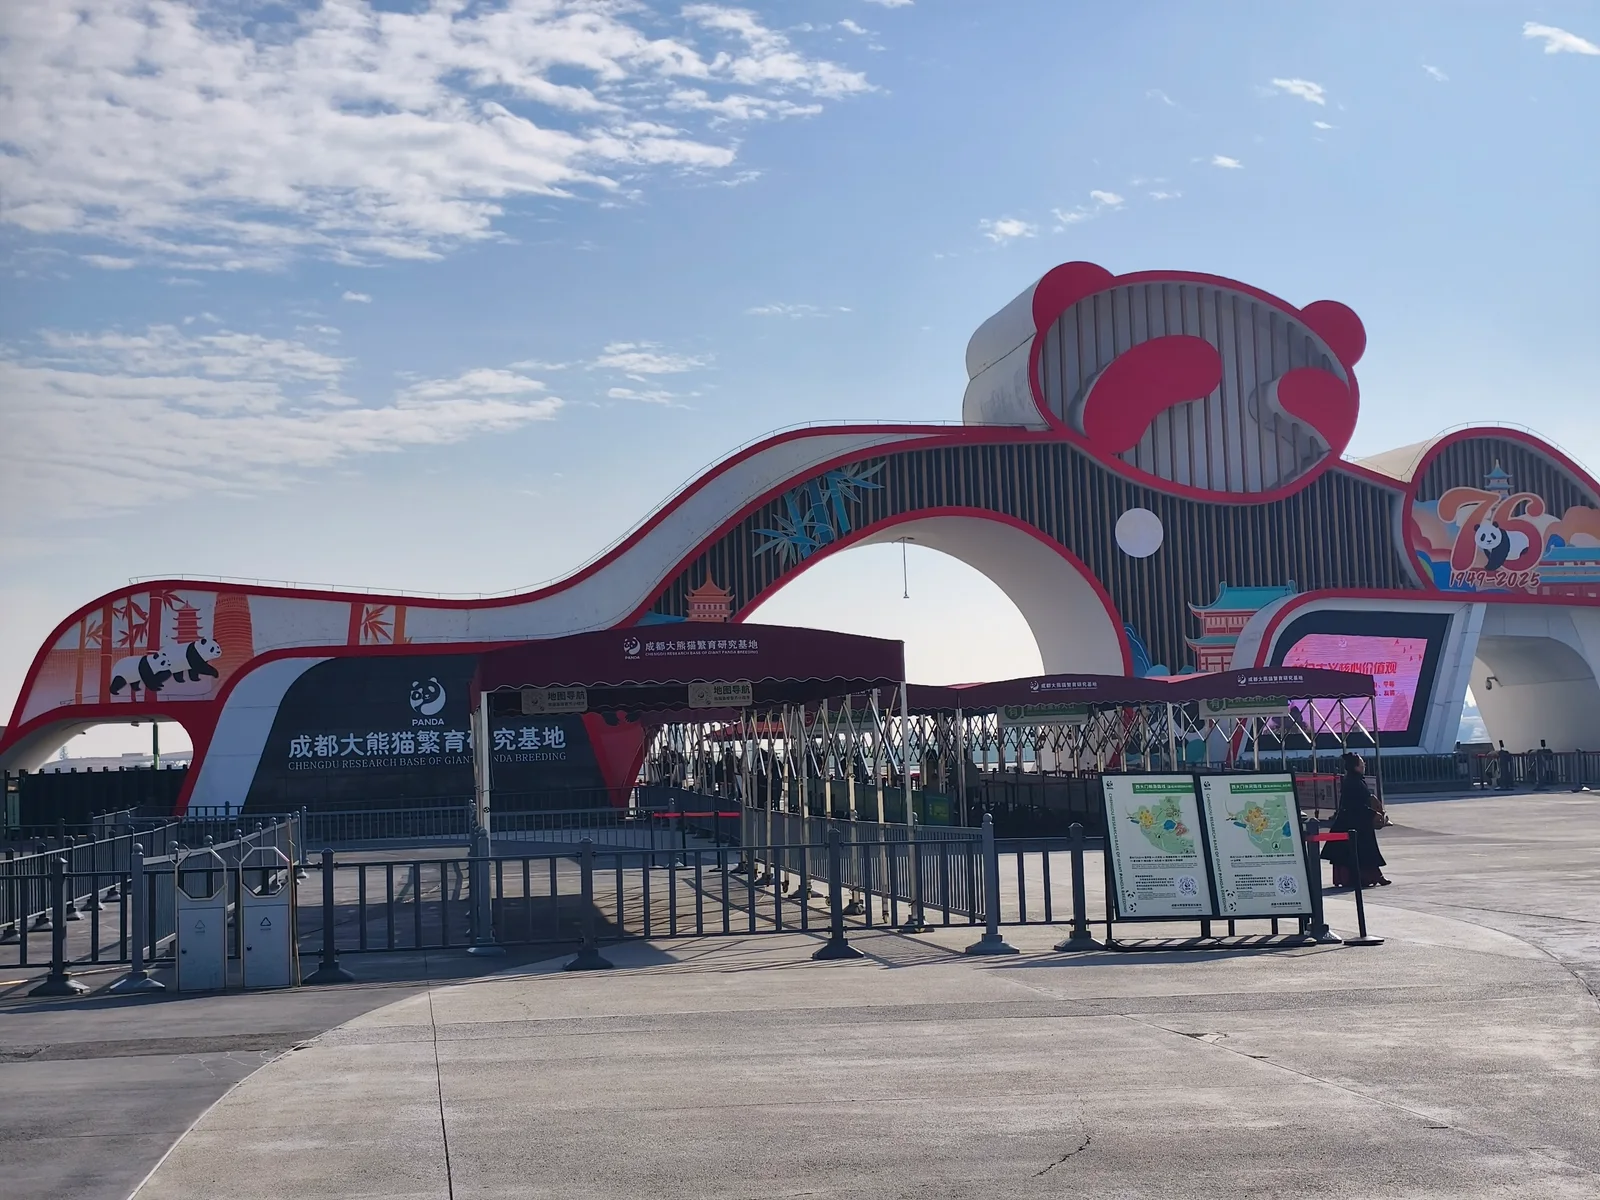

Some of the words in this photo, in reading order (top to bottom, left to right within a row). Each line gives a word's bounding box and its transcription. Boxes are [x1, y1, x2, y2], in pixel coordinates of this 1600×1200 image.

[1437, 486, 1545, 572] 76
[1449, 571, 1541, 588] 1949-2025
[645, 639, 759, 652] 成都大熊猫繁育研究基地
[1292, 661, 1397, 674] 义核心价值观
[548, 690, 585, 701] 地图导航
[713, 685, 751, 695] 地图导航
[411, 718, 445, 727] PANDA
[288, 760, 339, 771] CHENGDU
[342, 758, 397, 769] RESEARCH
[400, 757, 427, 767] BASE
[428, 756, 442, 766] OF
[515, 752, 567, 762] BREEDING
